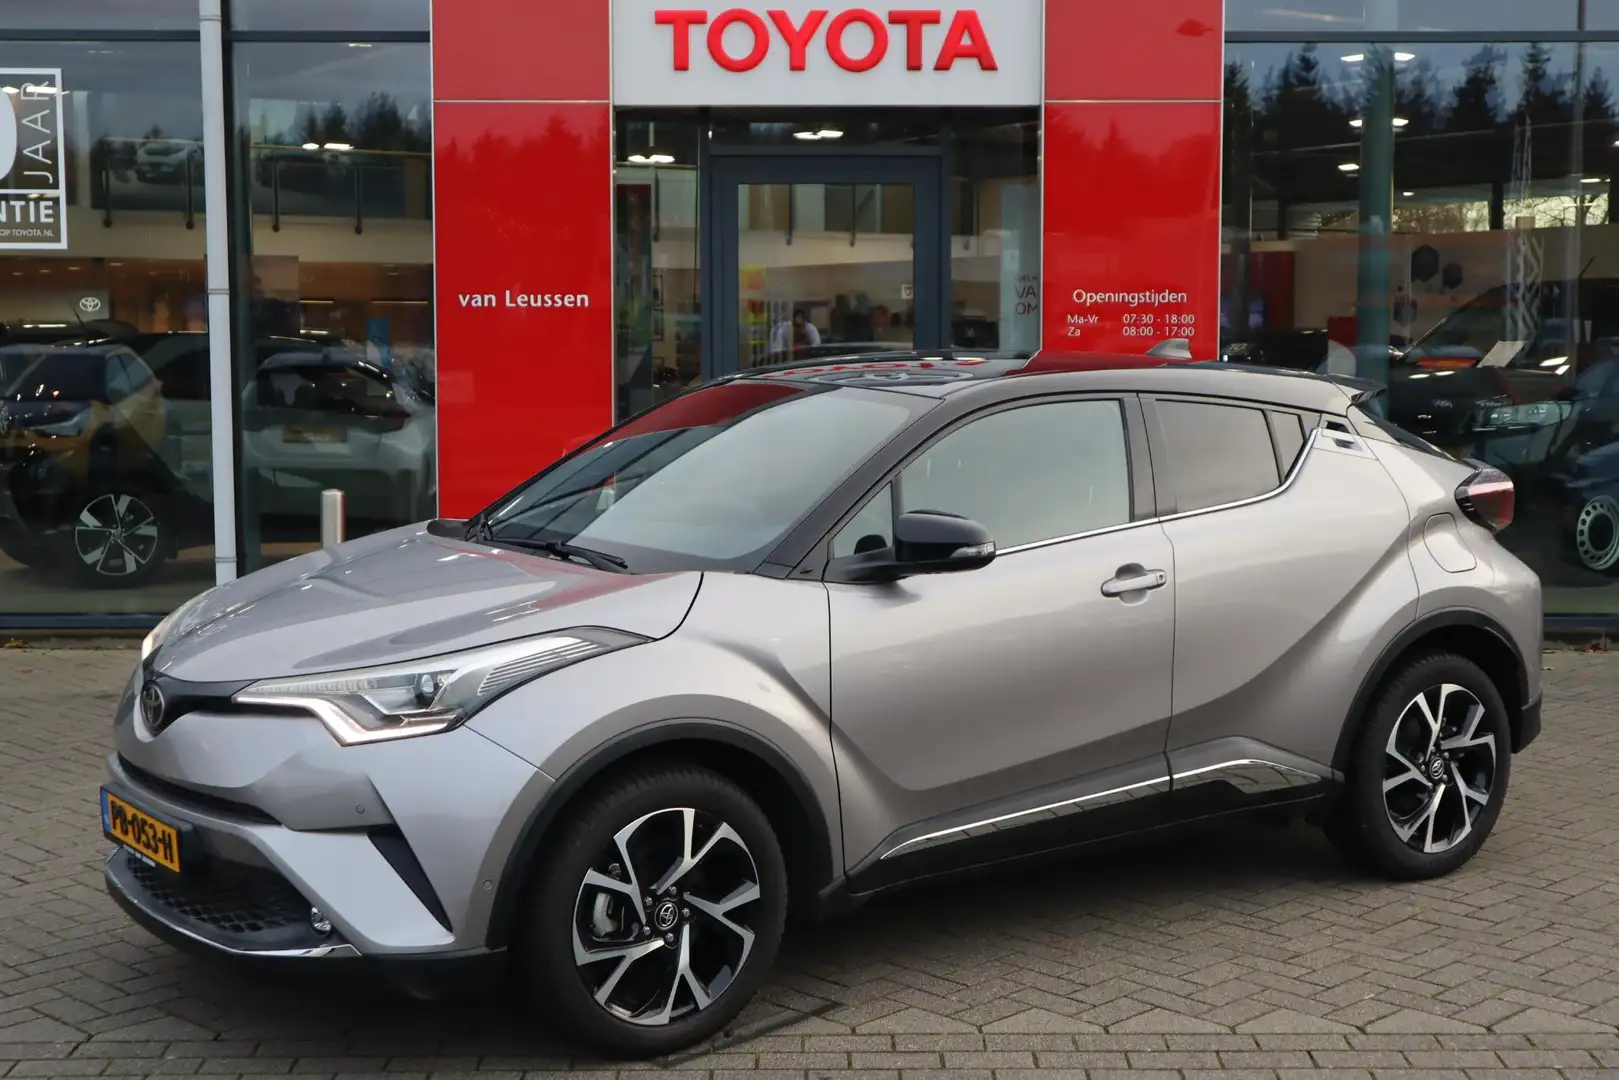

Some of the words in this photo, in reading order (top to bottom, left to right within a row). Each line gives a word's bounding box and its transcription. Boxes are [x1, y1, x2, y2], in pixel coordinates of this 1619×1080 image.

[654, 8, 998, 72] TOYOTA
[20, 81, 53, 184] JAAR
[459, 294, 496, 307] van
[505, 290, 589, 307] Leussen
[1072, 289, 1187, 307] Openingstijden
[1067, 314, 1099, 324] Ma-Vr
[1122, 314, 1154, 324] 07:30
[1164, 314, 1195, 324] 18:00
[1067, 327, 1081, 336] Za
[1122, 327, 1154, 336] 08:00
[1164, 327, 1195, 336] 17:00
